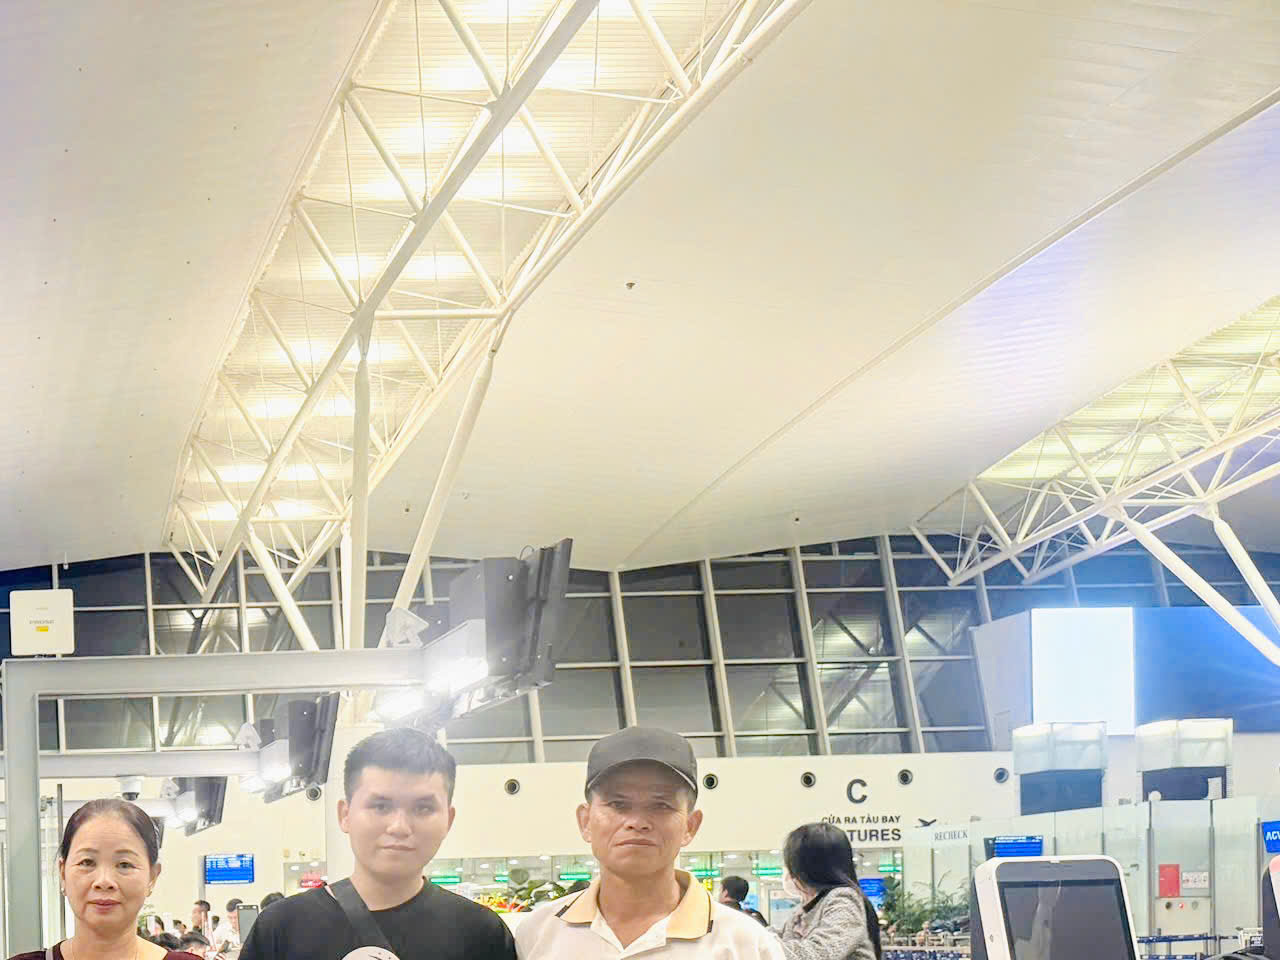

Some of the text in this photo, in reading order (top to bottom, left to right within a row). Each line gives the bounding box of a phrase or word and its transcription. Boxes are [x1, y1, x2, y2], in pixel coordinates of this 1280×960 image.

[846, 779, 868, 804] C
[860, 814, 879, 824] TÀU
[847, 828, 902, 842] TURES
[934, 830, 968, 841] RECHECK
